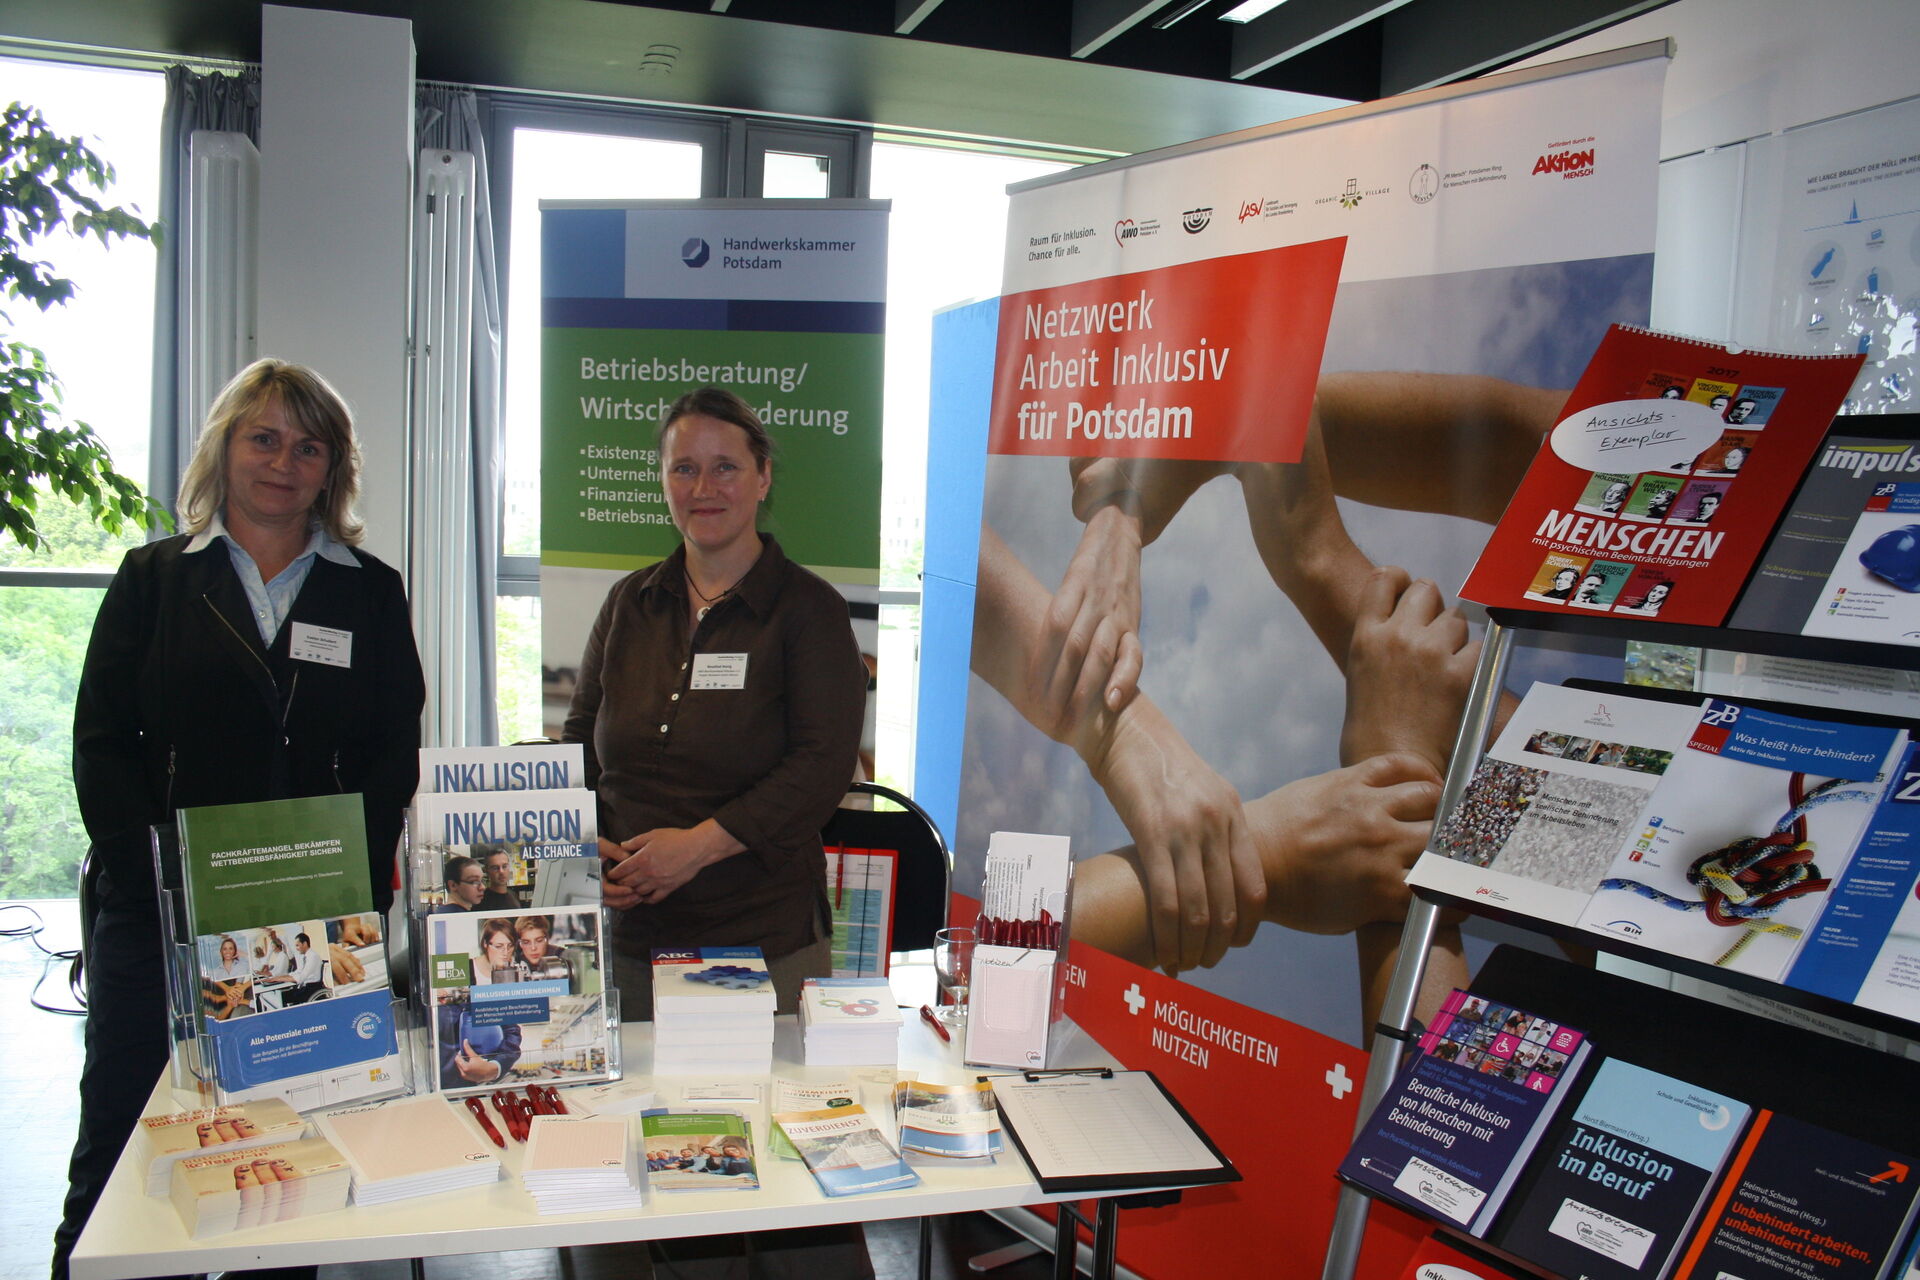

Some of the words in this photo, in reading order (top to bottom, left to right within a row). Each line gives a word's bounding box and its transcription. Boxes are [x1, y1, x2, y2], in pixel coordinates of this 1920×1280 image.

[1563, 168, 1593, 179] MENSCH
[723, 237, 856, 253] Handwerkskammer
[1030, 235, 1049, 247] Raum
[1051, 233, 1061, 244] für
[1063, 226, 1096, 241] Inklusion.
[1121, 227, 1138, 239] AWO
[723, 256, 782, 270] Potsdam
[1028, 250, 1052, 262] Chance
[1055, 247, 1064, 257] für
[1067, 245, 1081, 255] alle.
[1024, 289, 1154, 341] Netzwerk
[581, 357, 807, 392] Betriebsberatung/
[1019, 348, 1099, 392] Arbeit
[1112, 336, 1230, 386] Inklusiv
[1707, 366, 1740, 378] 2017
[581, 397, 848, 435] Wirtschderung
[1017, 402, 1058, 441] für
[1066, 397, 1193, 441] Potsdam
[588, 508, 675, 525] Betriebsnac
[1536, 509, 1726, 560] MENSCHEN
[1532, 537, 1548, 547] mit
[1549, 541, 1609, 559] psychischen
[1610, 551, 1709, 569] Beeinträchtigungen
[1701, 703, 1741, 726] ZB
[1688, 740, 1719, 754] SPEZIAL
[1735, 732, 1758, 744] Was
[1760, 737, 1789, 752] heißt
[1789, 743, 1812, 754] hier
[1814, 748, 1876, 763] behindert?
[435, 761, 569, 792] INKLUSION
[1535, 803, 1571, 815] seelischer
[1572, 810, 1620, 826] Behinderung
[1542, 793, 1577, 807] Menschen
[445, 809, 581, 845] INKLUSION
[1541, 815, 1586, 829] Arbeitsleben
[211, 844, 293, 859] FACHKRÄFTEMANGEL
[294, 839, 341, 850] BEKÄMPFEN
[211, 850, 308, 867] WETTBEWERBSFÄHIGKEIT
[310, 847, 343, 857] SICHERN
[522, 845, 541, 859] ALS
[543, 844, 582, 858] CHANCE
[1624, 926, 1642, 935] BIH
[446, 968, 466, 978] BDA
[474, 991, 510, 999] INKLUSION
[511, 987, 561, 996] UNTERNEHMEN
[250, 1038, 264, 1046] Alle
[266, 1028, 302, 1043] Potenziale
[303, 1024, 327, 1035] nutzen
[1152, 1026, 1209, 1070] NUTZEN
[1154, 999, 1279, 1068] MÖGLICHKEITEN
[1407, 1077, 1460, 1109] Berufliche
[1460, 1099, 1510, 1129] Inklusion
[787, 1119, 863, 1134] ZUVERDIENST
[1388, 1107, 1456, 1148] Behinderung
[1399, 1095, 1421, 1110] von
[1417, 1100, 1472, 1133] Menschen
[1472, 1125, 1494, 1143] mit
[1582, 1114, 1599, 1124] Horst
[1599, 1119, 1627, 1135] Biermann
[1626, 1129, 1650, 1144] (Hrsg.)
[1569, 1127, 1674, 1181] Inklusion
[1557, 1149, 1587, 1176] im
[1587, 1161, 1656, 1201] Beruf
[1739, 1188, 1759, 1204] Georg
[1760, 1193, 1800, 1217] Theunissen
[1799, 1209, 1827, 1227] (Hrsg.)
[1743, 1180, 1769, 1196] Helmut
[1768, 1188, 1799, 1206] Schwalb
[1724, 1216, 1803, 1252] unbehindert
[1804, 1245, 1842, 1268] leben
[1731, 1201, 1811, 1239] Unbehindert
[1811, 1231, 1873, 1264] arbeiten,
[1714, 1237, 1784, 1270] Lernschwierigkeiten
[1718, 1228, 1751, 1248] Inklusion
[1751, 1240, 1764, 1251] von
[1765, 1246, 1800, 1266] Menschen
[1800, 1259, 1815, 1272] mit
